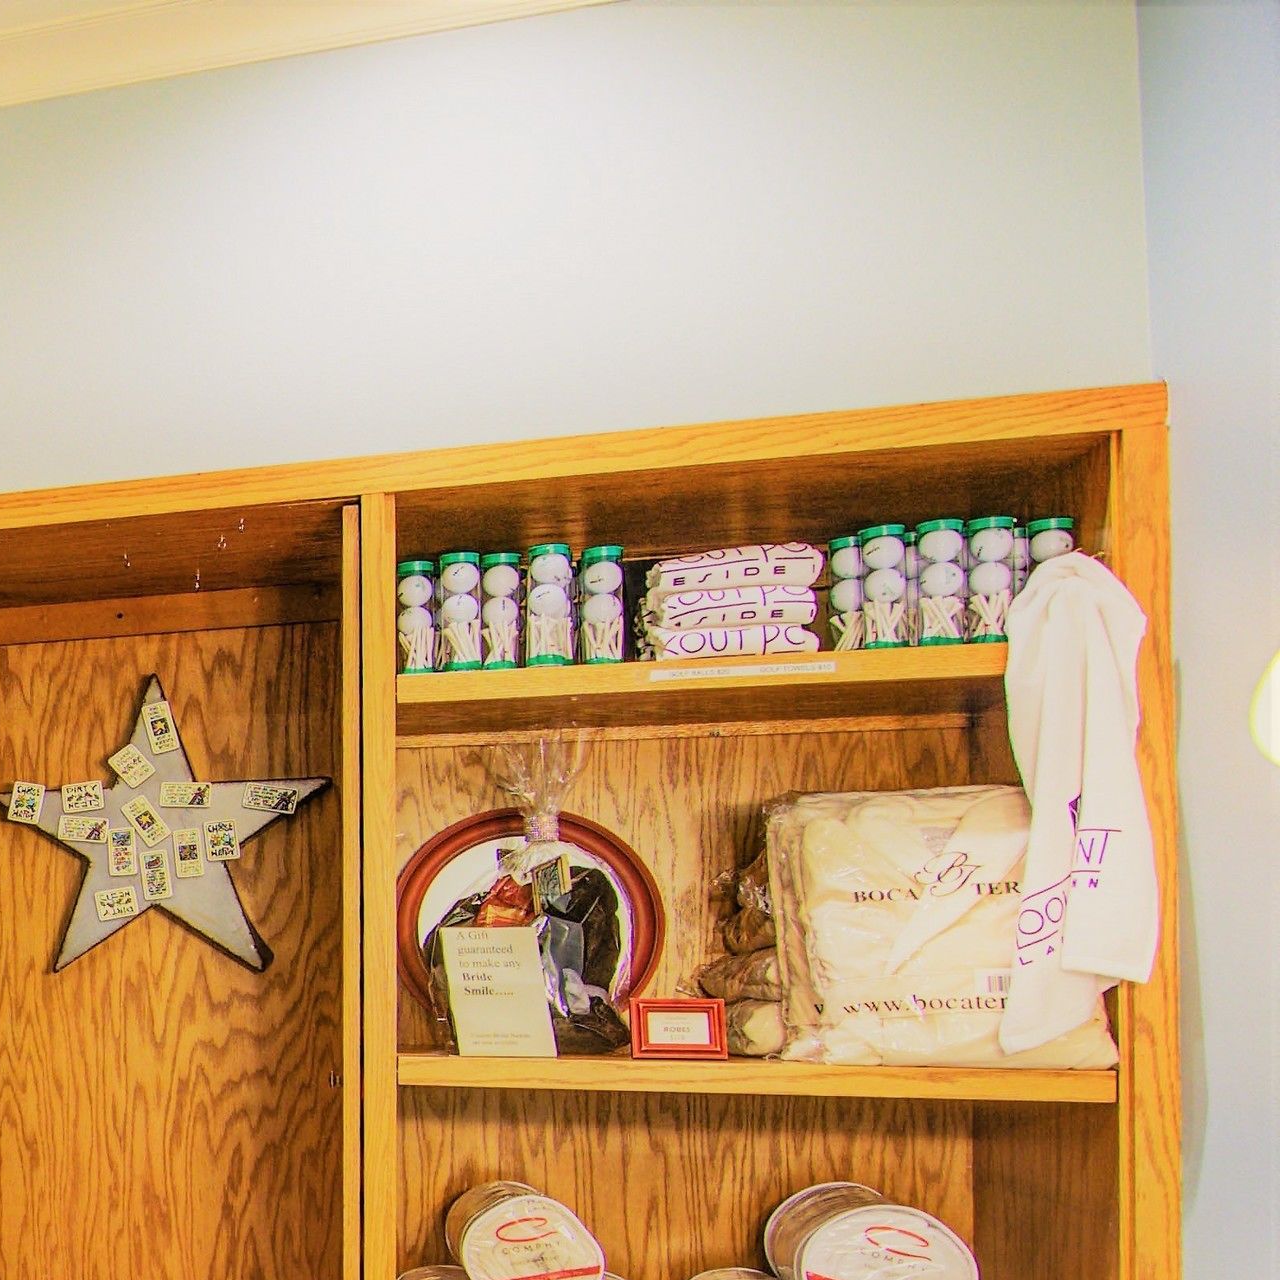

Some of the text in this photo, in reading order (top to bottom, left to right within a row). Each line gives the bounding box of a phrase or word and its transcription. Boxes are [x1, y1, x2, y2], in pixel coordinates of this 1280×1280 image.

[853, 881, 1022, 903] BOCA TER
[468, 930, 489, 941] Gift
[457, 944, 514, 957] guaranteed
[459, 959, 522, 970] to make any
[462, 972, 493, 982] Bride
